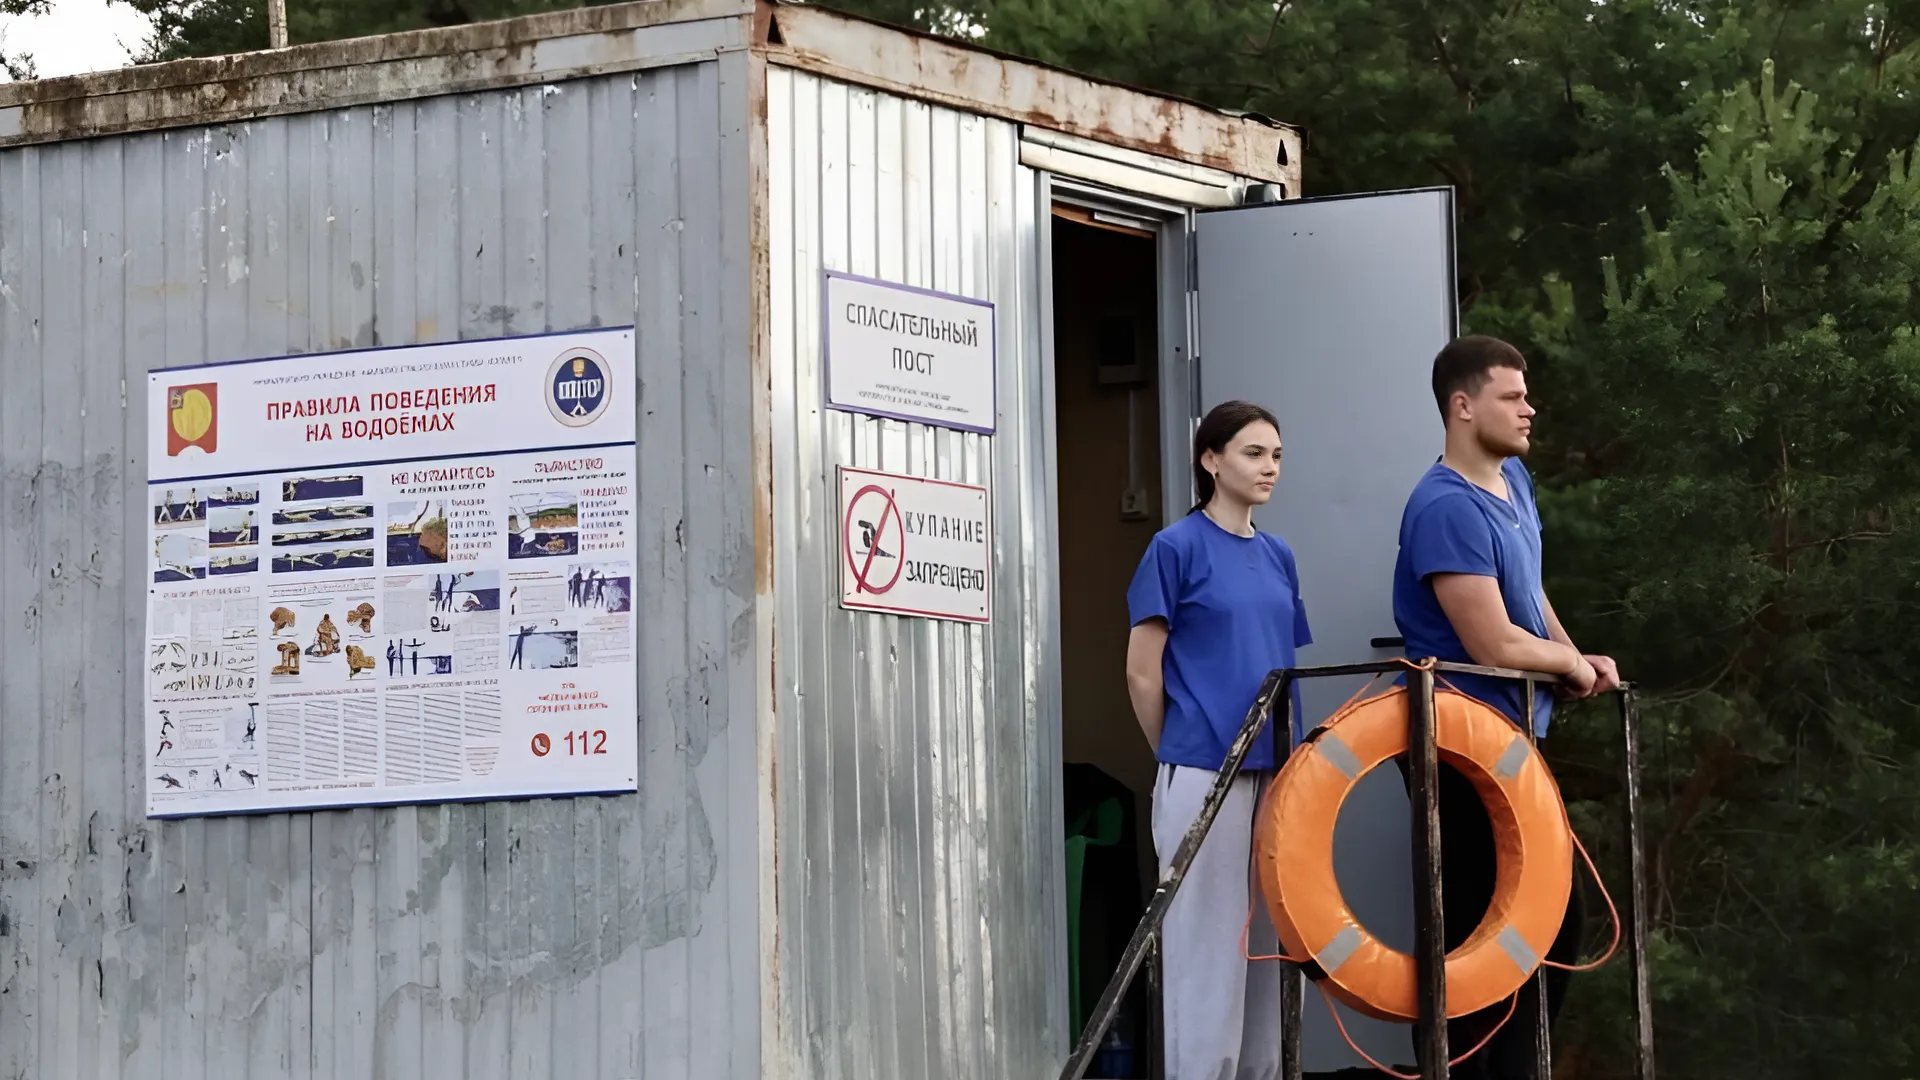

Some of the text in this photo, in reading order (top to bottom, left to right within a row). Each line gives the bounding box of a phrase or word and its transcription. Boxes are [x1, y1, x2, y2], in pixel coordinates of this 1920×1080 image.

[846, 302, 978, 347] СПАСАТЕЛЬНЫЙ
[892, 347, 935, 376] ПОСТ
[267, 383, 496, 421] ПРАВИЛА ПОВЕДЕНИЯ
[306, 411, 455, 442] НА ВОДОЁМАХ
[905, 511, 984, 544] КУПАНИЕ
[905, 560, 985, 593] ЗАПРЕЩЕНО
[563, 729, 608, 756] 112
